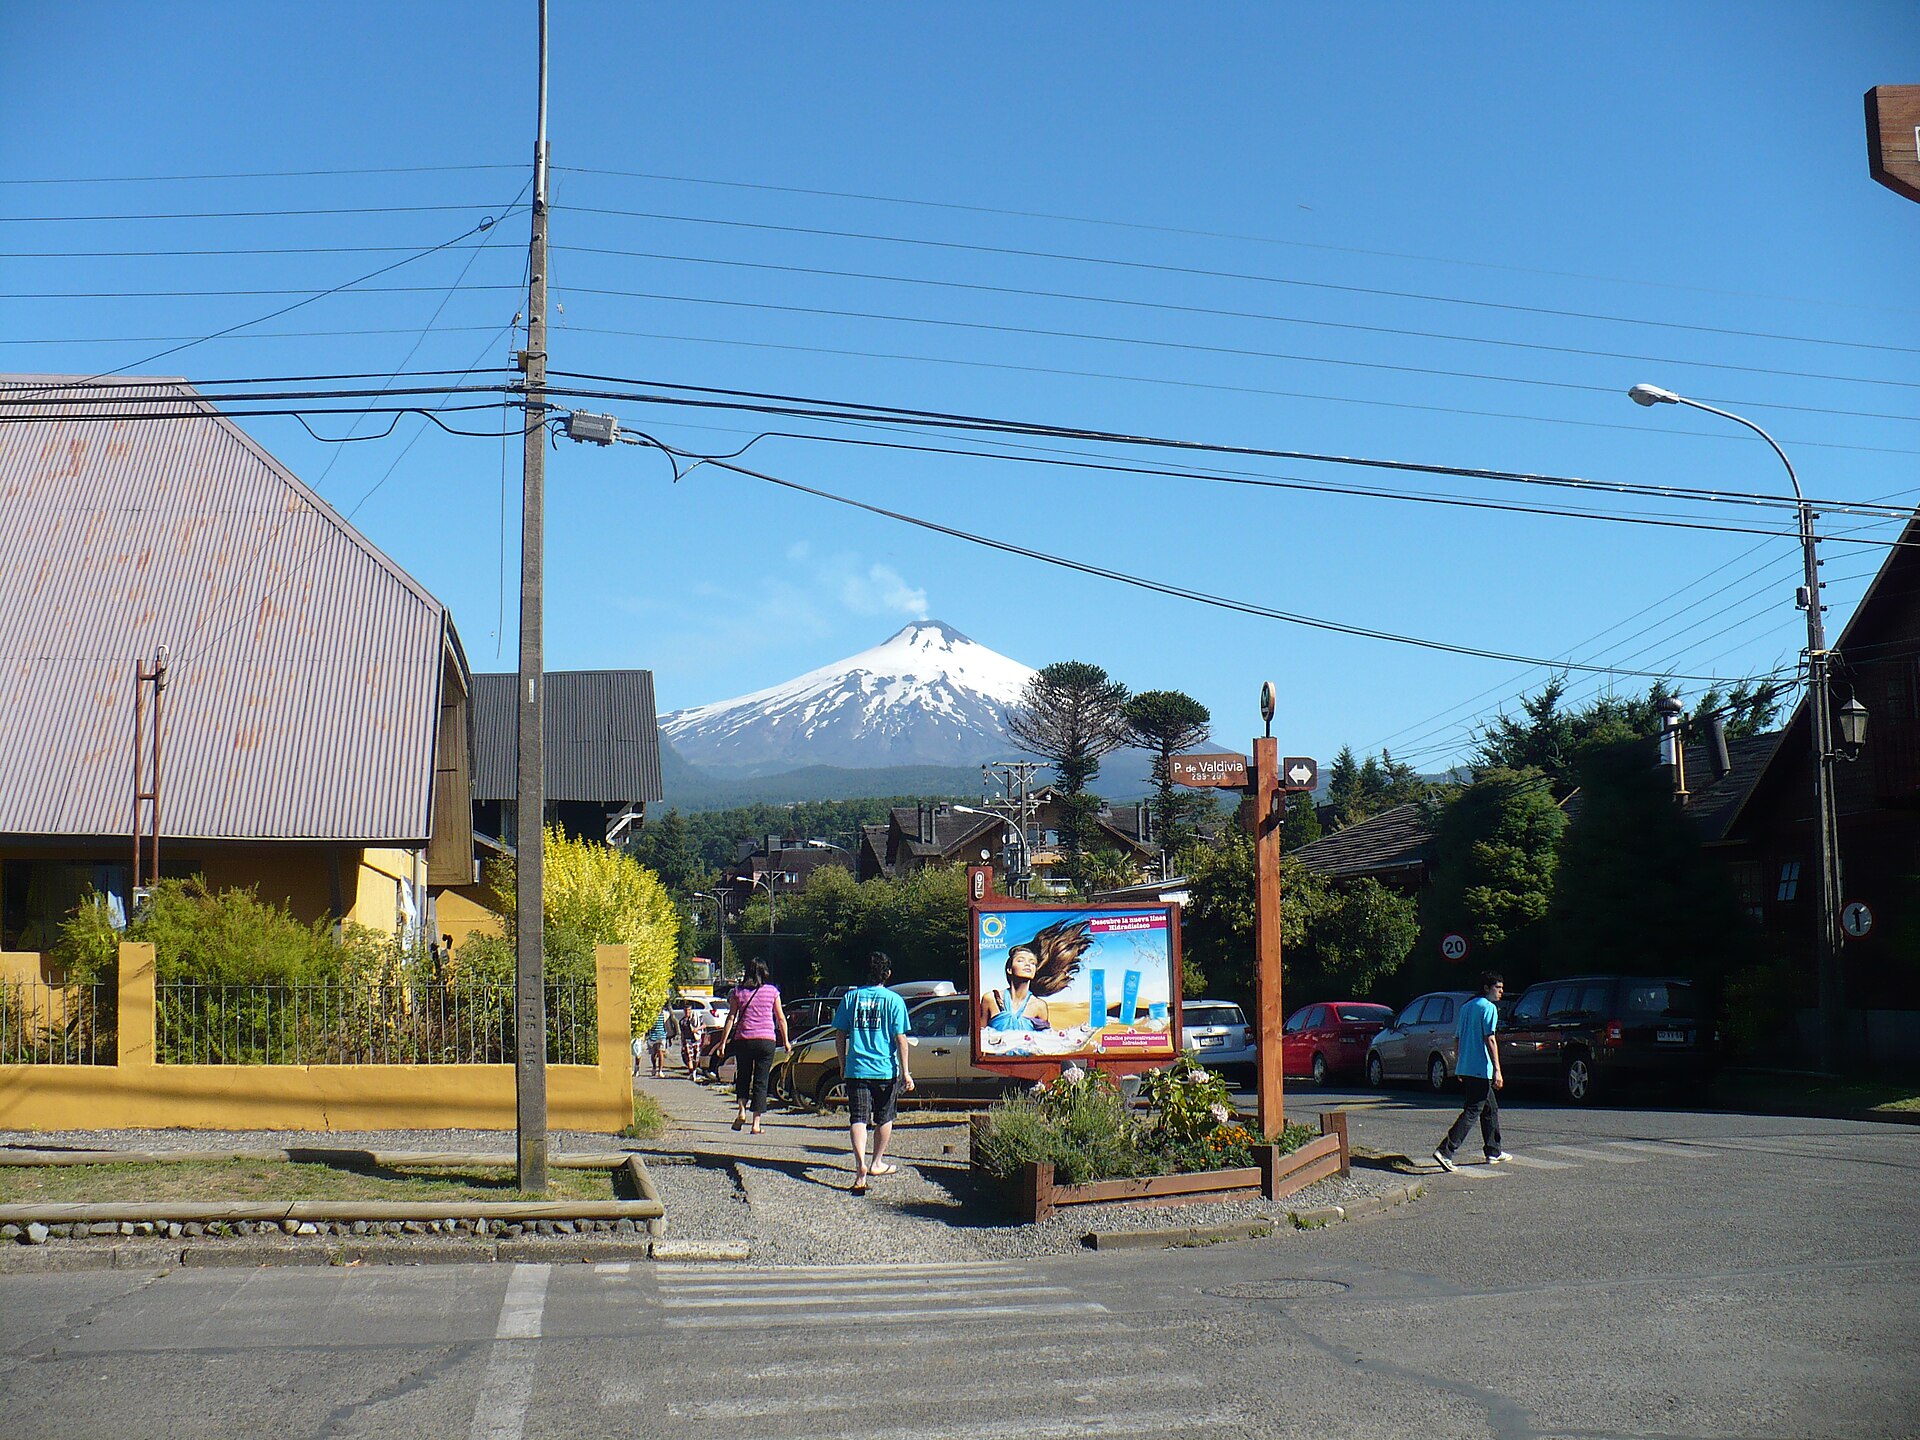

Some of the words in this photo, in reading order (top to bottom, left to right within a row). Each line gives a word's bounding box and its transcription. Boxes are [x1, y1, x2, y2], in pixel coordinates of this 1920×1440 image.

[1174, 762, 1183, 773] P.
[1185, 764, 1197, 773] de
[1198, 760, 1244, 773] Valdivia
[1091, 918, 1121, 926] Descubre
[982, 936, 1004, 944] Herbal
[1445, 940, 1464, 954] 20
